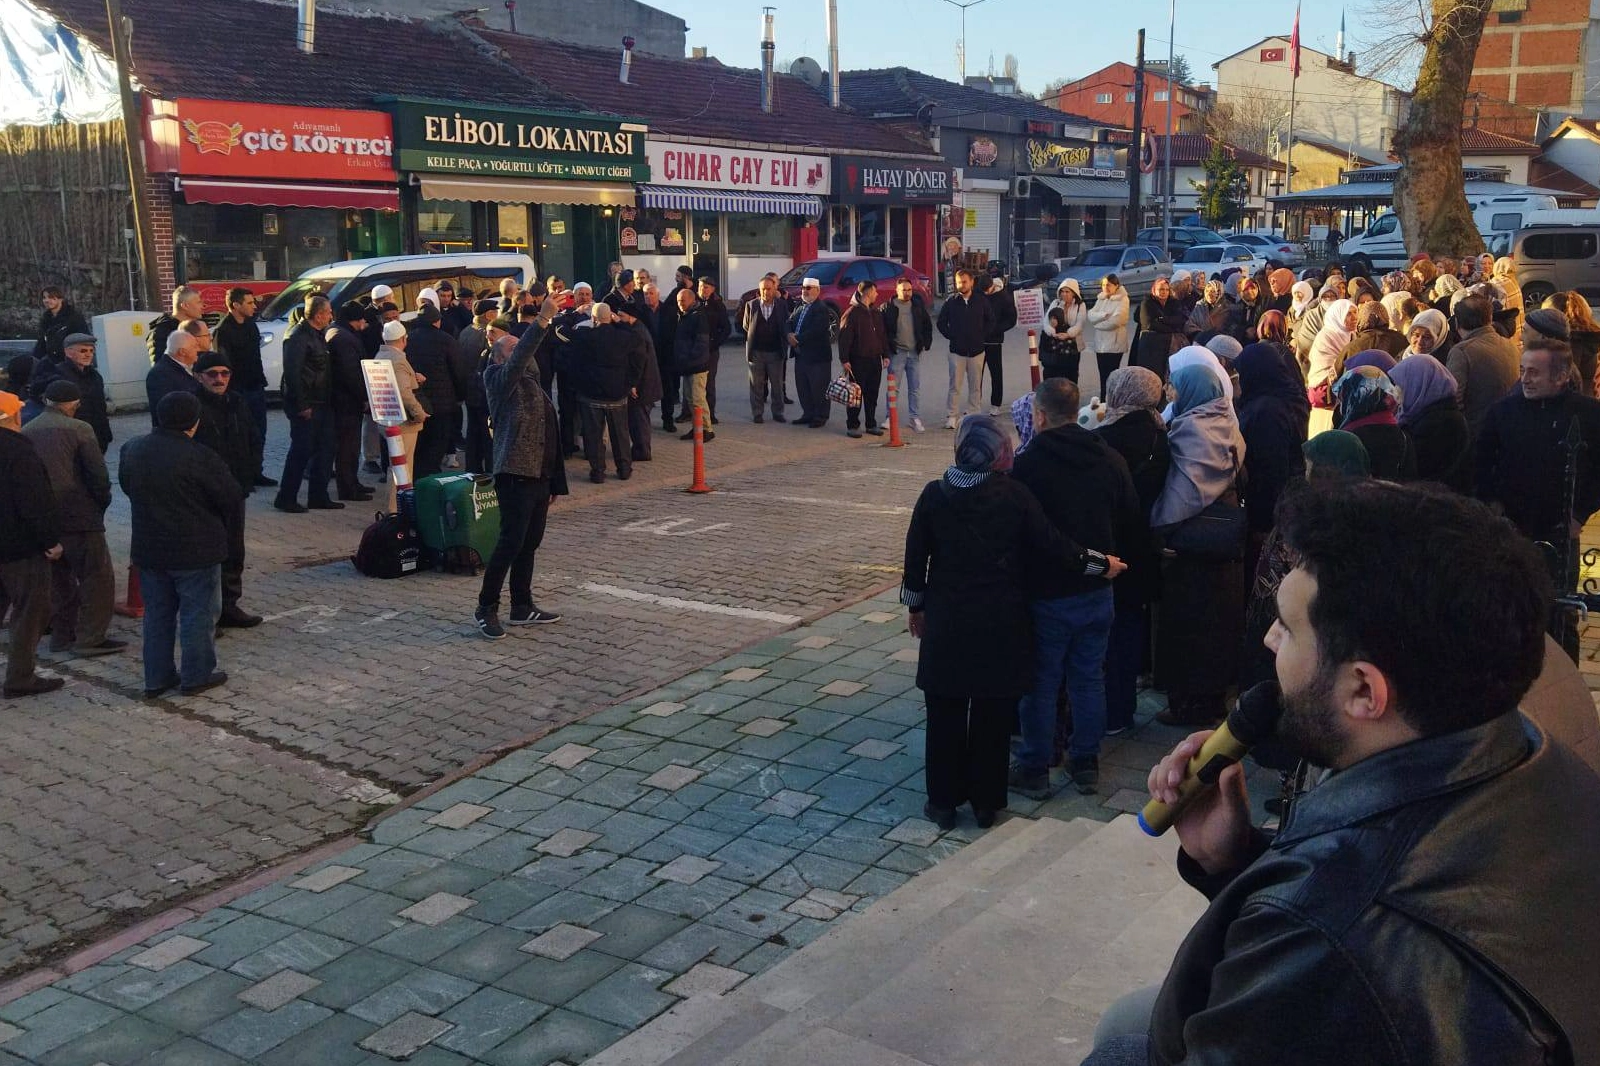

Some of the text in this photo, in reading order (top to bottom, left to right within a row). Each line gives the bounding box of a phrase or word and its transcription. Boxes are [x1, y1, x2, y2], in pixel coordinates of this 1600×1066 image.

[292, 121, 341, 133] Adıyamanlı
[424, 112, 633, 155] ELİBOL LOKANTASI
[243, 128, 288, 155] ÇİĞ
[293, 132, 393, 157] KÖFTECİ
[347, 158, 372, 168] Erkan
[427, 156, 632, 178] KELLE PAÇA YOĞURTLU KÖFTE ARNAVUT CİĞERİ
[663, 150, 798, 187] ÇINAR ÇAY EVİ
[863, 167, 947, 189] HATAY DÖNER
